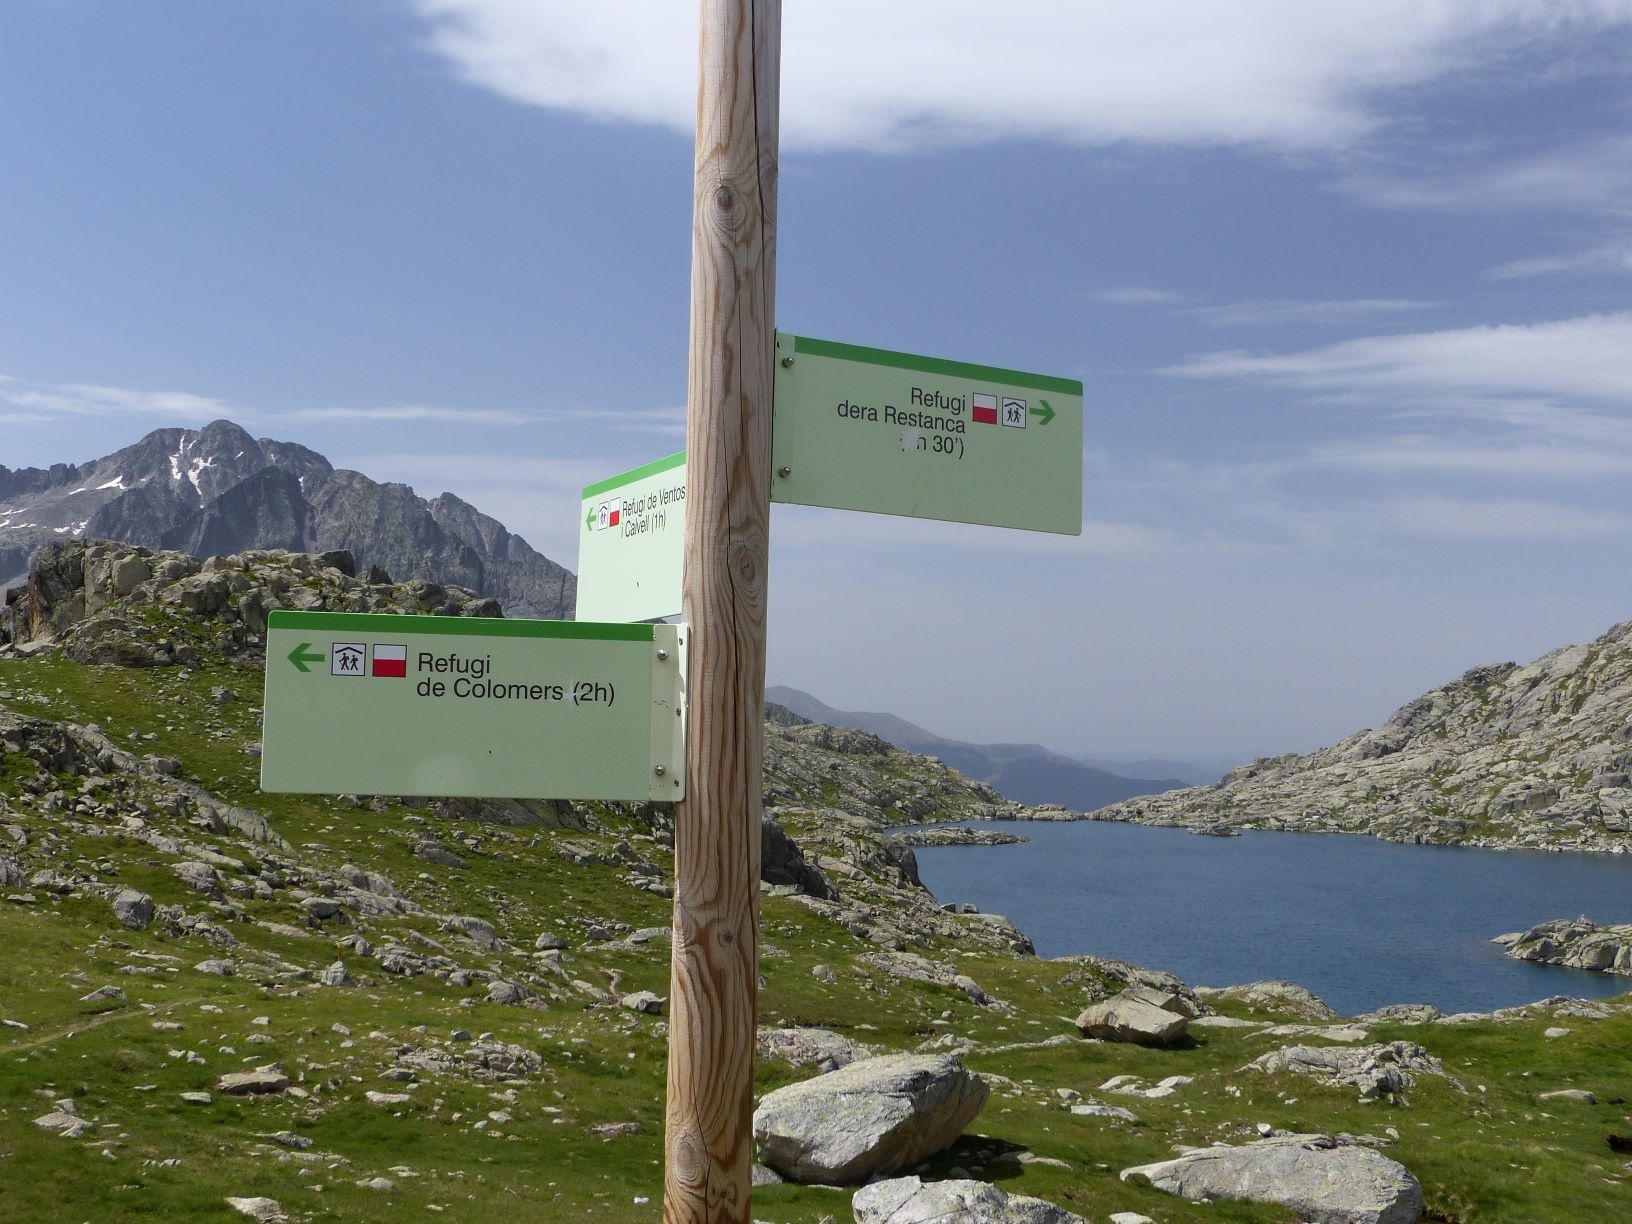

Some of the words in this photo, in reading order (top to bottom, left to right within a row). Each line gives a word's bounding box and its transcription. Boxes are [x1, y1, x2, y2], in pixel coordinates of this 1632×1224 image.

[911, 387, 966, 415] Refugi
[837, 400, 878, 421] dera
[884, 406, 966, 433] Restanca
[932, 435, 964, 460] 30')
[622, 494, 646, 518] Refugi
[647, 492, 657, 510] de
[625, 514, 649, 538] Calvell
[651, 510, 666, 535] (1h)
[417, 652, 491, 678] Refugi
[416, 678, 445, 697] de
[453, 678, 563, 701] Colomers
[573, 682, 615, 706] (2h)
